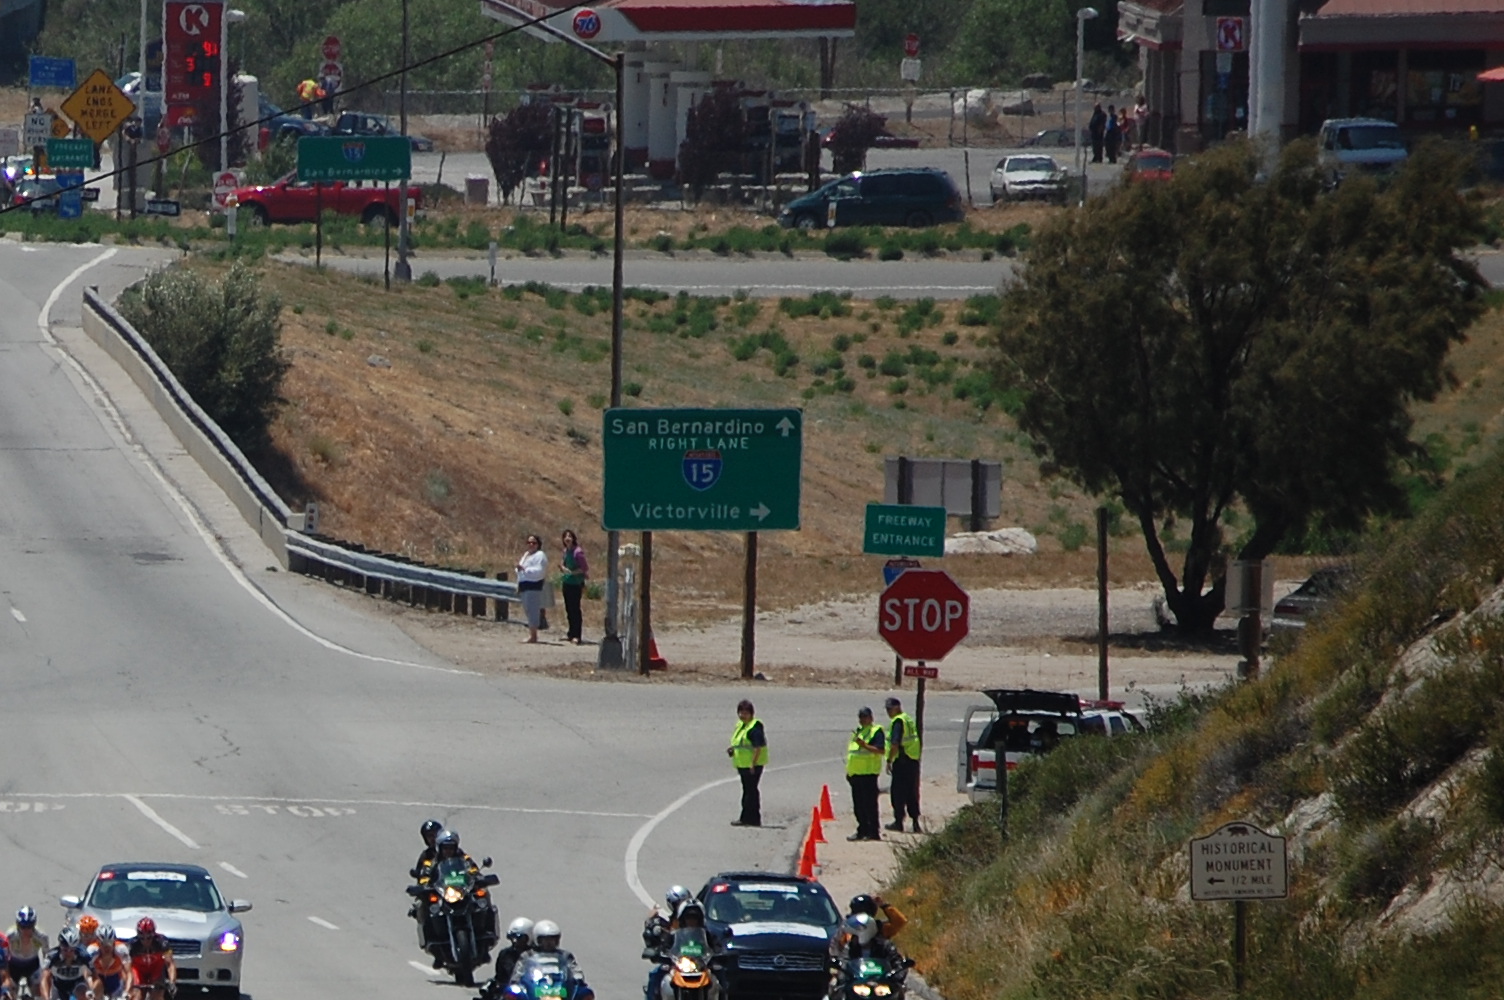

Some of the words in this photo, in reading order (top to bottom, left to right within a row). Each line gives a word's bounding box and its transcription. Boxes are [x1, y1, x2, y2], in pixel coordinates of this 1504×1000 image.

[576, 15, 597, 32] 76
[84, 85, 113, 94] LANE
[85, 97, 113, 106] ENDS
[80, 109, 117, 118] MERGE
[31, 118, 45, 126] NO
[85, 121, 112, 130] LEFT
[303, 168, 325, 177] San
[612, 419, 648, 434] San
[657, 419, 764, 435] Bernardino
[649, 437, 698, 450] RIGHT
[707, 437, 749, 450] LANE
[690, 463, 714, 483] 15
[631, 503, 740, 519] Victorville
[878, 515, 933, 528] FREEWAY
[872, 533, 936, 547] ENTRANCE
[884, 598, 963, 632] STOP
[1201, 842, 1275, 855] HISTORICAL
[1205, 859, 1273, 872] MONUMENT
[1231, 876, 1247, 885] 1/2
[1251, 875, 1273, 885] MILE
